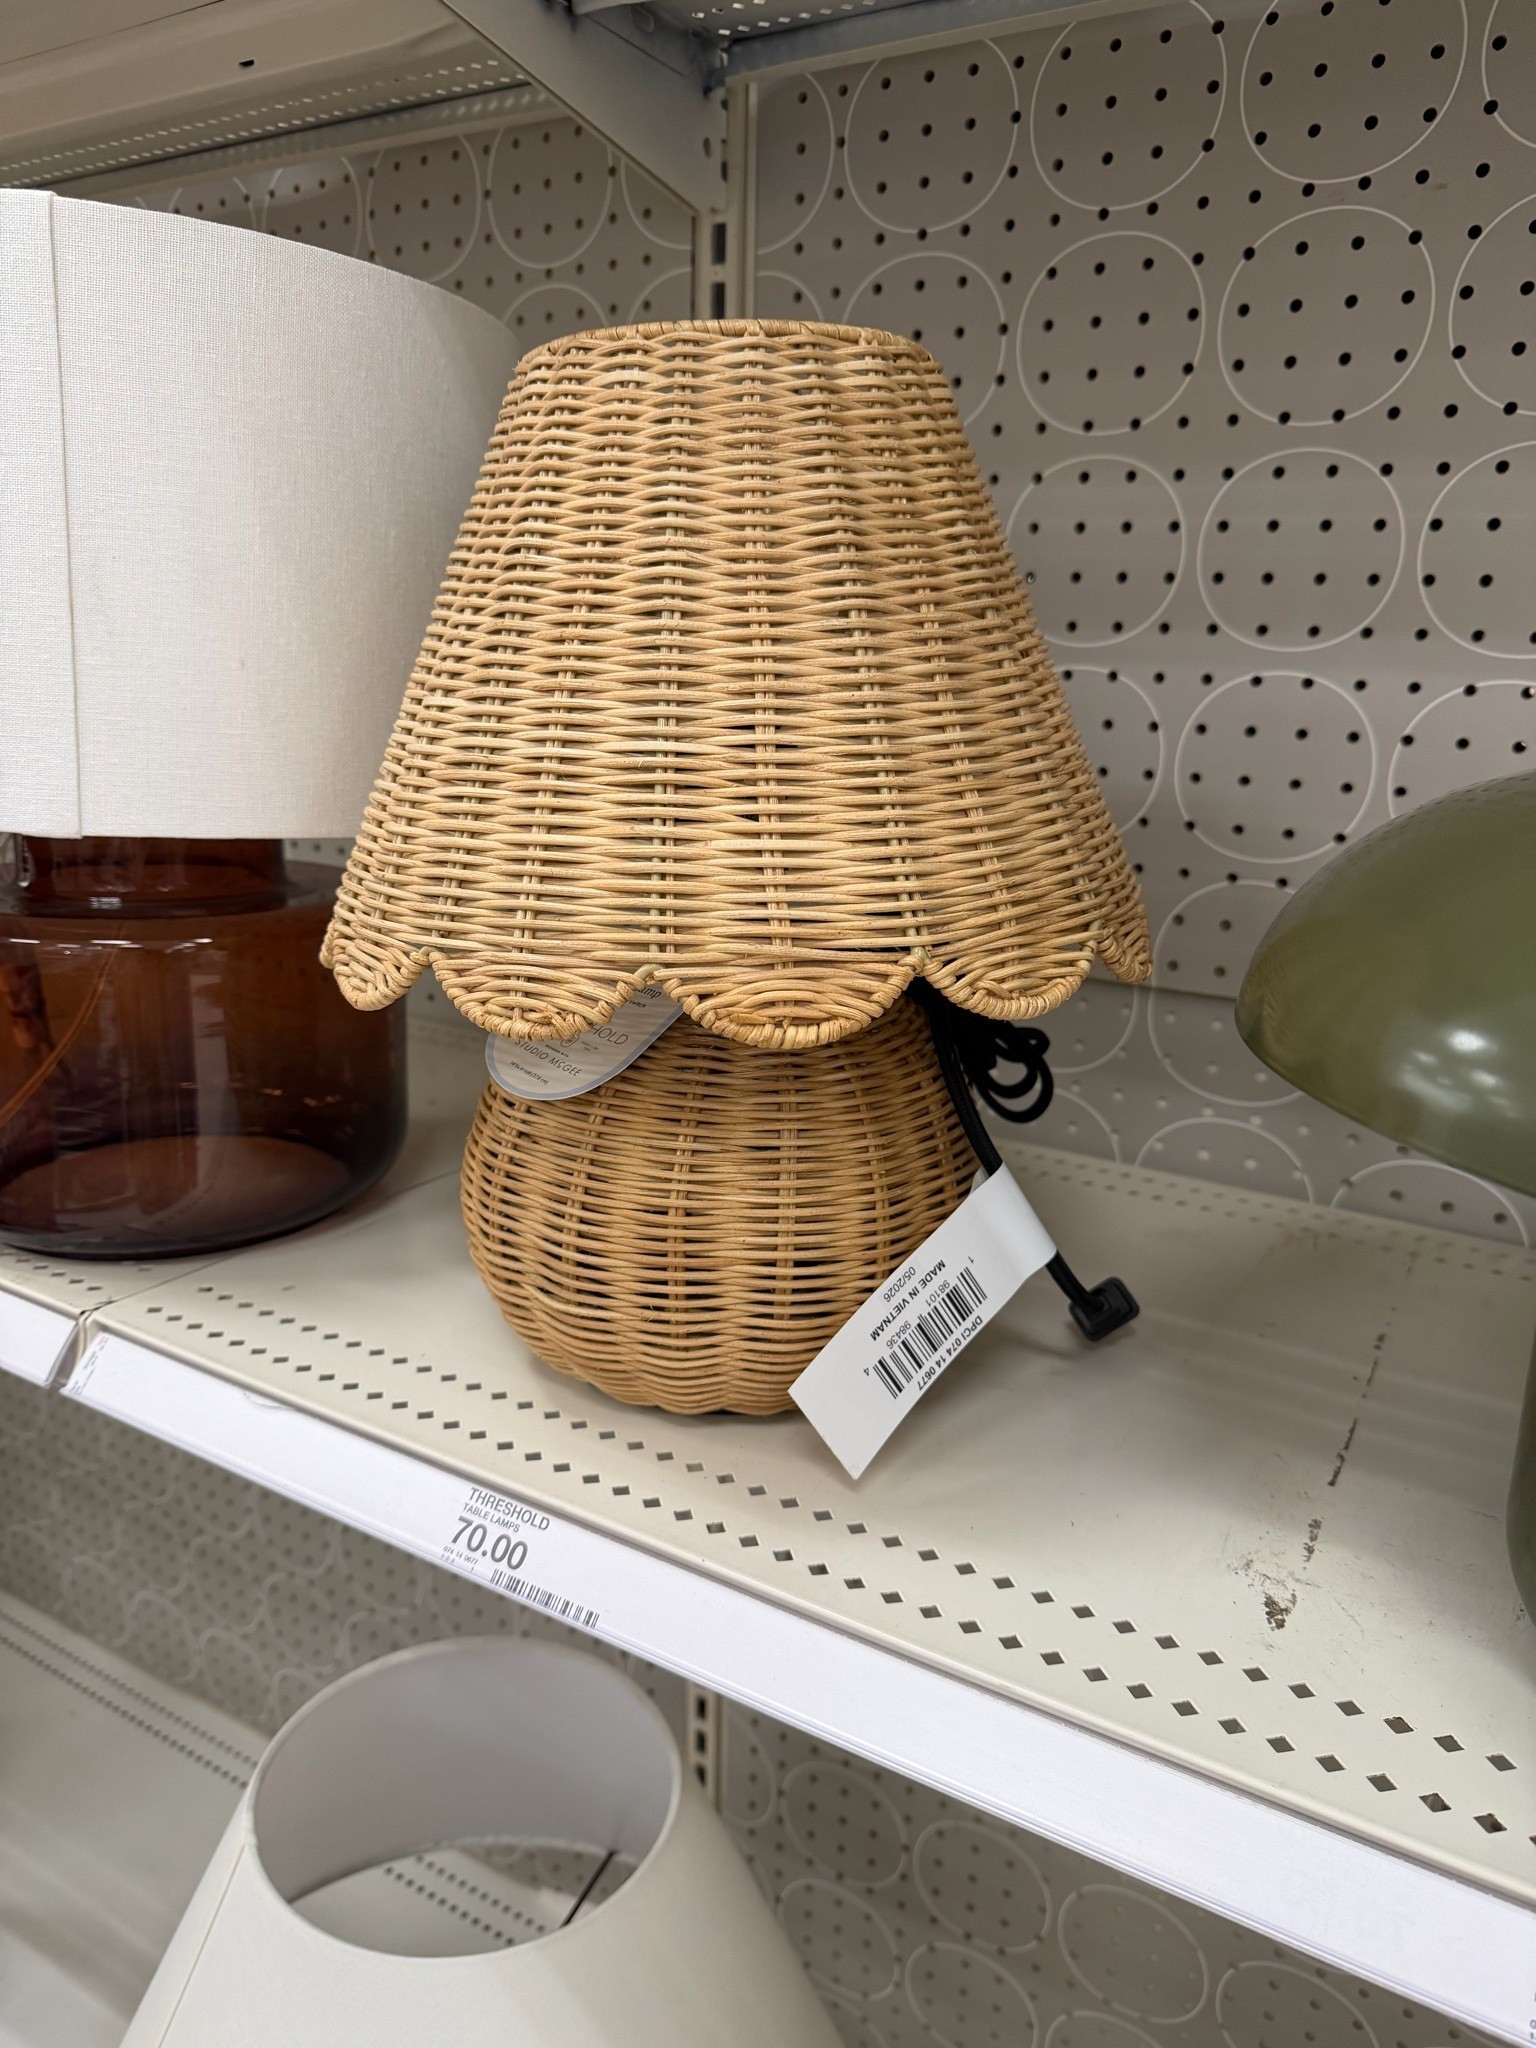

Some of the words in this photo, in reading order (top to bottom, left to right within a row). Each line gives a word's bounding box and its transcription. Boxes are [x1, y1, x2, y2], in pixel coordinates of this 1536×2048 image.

[918, 1259, 946, 1289] MADE
[968, 1256, 974, 1264] 1
[883, 1266, 916, 1303] 05/2026
[908, 1286, 920, 1300] IN
[925, 1279, 951, 1308] 98101
[870, 1298, 910, 1342] VIETNAM
[961, 1315, 983, 1340] DPCI
[886, 1320, 912, 1350] 98436
[946, 1338, 962, 1357] 074
[863, 1367, 870, 1377] 4
[935, 1355, 946, 1369] 14
[917, 1366, 936, 1391] 0677
[463, 1502, 491, 1520] TABLE
[490, 1513, 521, 1533] LAMPS
[469, 1487, 550, 1531] THRESHOLD
[451, 1515, 528, 1571] 70.00
